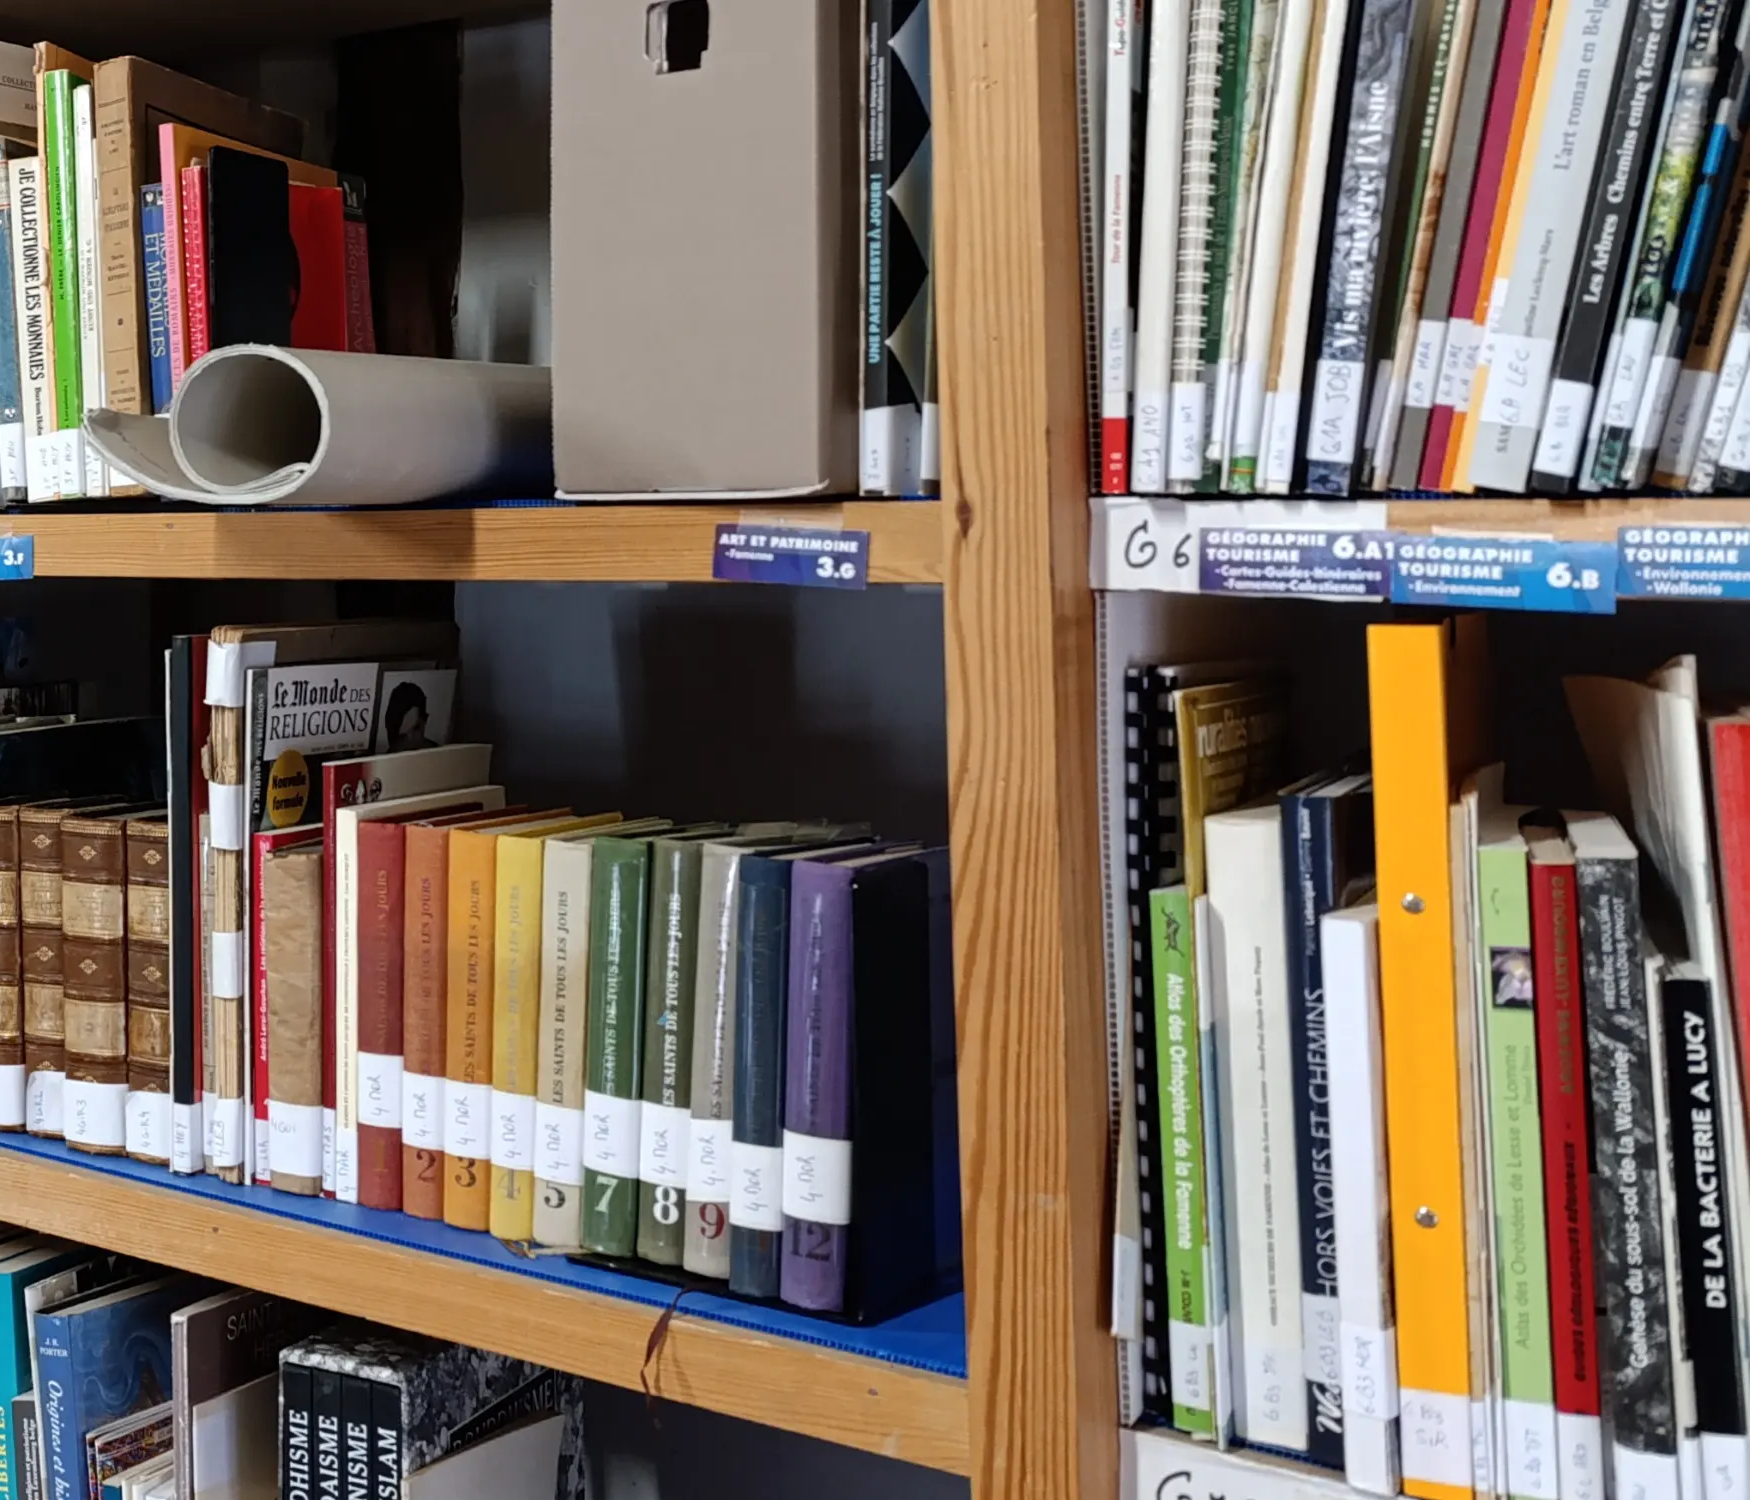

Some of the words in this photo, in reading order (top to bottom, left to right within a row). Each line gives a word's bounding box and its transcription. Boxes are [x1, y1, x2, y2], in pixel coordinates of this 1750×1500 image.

[1652, 13, 1665, 29] et
[1634, 31, 1660, 80] Terre
[1553, 131, 1578, 170] L'art
[1567, 69, 1591, 126] roman
[1582, 42, 1595, 63] en
[1627, 82, 1651, 126] entre
[1354, 80, 1389, 164] l'Aisne
[19, 168, 35, 184] JE
[1607, 130, 1638, 203] Chemins
[868, 182, 882, 227] JOUER
[20, 187, 40, 283] COLLECTIONNE
[145, 232, 159, 256] ET
[1591, 214, 1618, 271] Arbres
[868, 240, 882, 283] RESTE
[25, 286, 42, 311] LES
[1345, 269, 1364, 306] ma
[1583, 273, 1603, 303] Les
[868, 284, 882, 334] PARTIE
[1334, 309, 1359, 348] Vis
[27, 315, 45, 381] MONNAIES
[868, 335, 881, 364] UNE
[3, 550, 24, 566] 3.F
[719, 533, 747, 546] ART
[751, 535, 767, 547] ET
[770, 536, 859, 553] PATRIMOINE
[1124, 518, 1157, 569] G
[1172, 533, 1191, 569] 6
[1206, 548, 1300, 562] TOURISME
[1332, 534, 1396, 560] 6.A1
[1624, 548, 1739, 565] TOURISME
[816, 556, 856, 580] 3.G
[1398, 562, 1503, 580] TOURISME
[1546, 562, 1599, 590] 6.B
[272, 681, 289, 709] Le
[289, 678, 348, 708] Monde
[349, 688, 371, 703] DES
[269, 707, 370, 741] RELIGIONS
[271, 771, 306, 789] Nouvelle
[272, 795, 304, 811] formule
[556, 891, 568, 934] JOURS
[556, 938, 567, 962] LES
[554, 965, 566, 1000] TOUS
[1166, 973, 1186, 1011] Atlas
[554, 1004, 565, 1023] DE
[1169, 1014, 1187, 1042] des
[553, 1028, 564, 1076] SAINTS
[1304, 987, 1331, 1104] CHEMINS
[1683, 1011, 1709, 1073] LUCY
[552, 1079, 563, 1104] LES
[1166, 1046, 1191, 1133] Orthoptères
[1691, 1080, 1710, 1102] A
[1311, 1112, 1331, 1138] ET
[1173, 1137, 1190, 1157] de
[1614, 1135, 1634, 1154] la
[1175, 1161, 1191, 1177] la
[1616, 1158, 1636, 1182] de
[1691, 1108, 1721, 1227] BACTERIE
[594, 1174, 618, 1213] 7
[1313, 1150, 1334, 1220] VOIES
[653, 1186, 679, 1224] 8
[700, 1202, 725, 1239] 9
[1172, 1181, 1192, 1249] Famenne
[1619, 1186, 1643, 1265] sous-sol
[1316, 1224, 1337, 1297] HORS
[1703, 1234, 1724, 1268] LA
[1624, 1268, 1643, 1295] du
[1705, 1275, 1727, 1308] DE
[1628, 1298, 1649, 1368] Genèse
[47, 1380, 65, 1452] Origines
[53, 1455, 67, 1475] et
